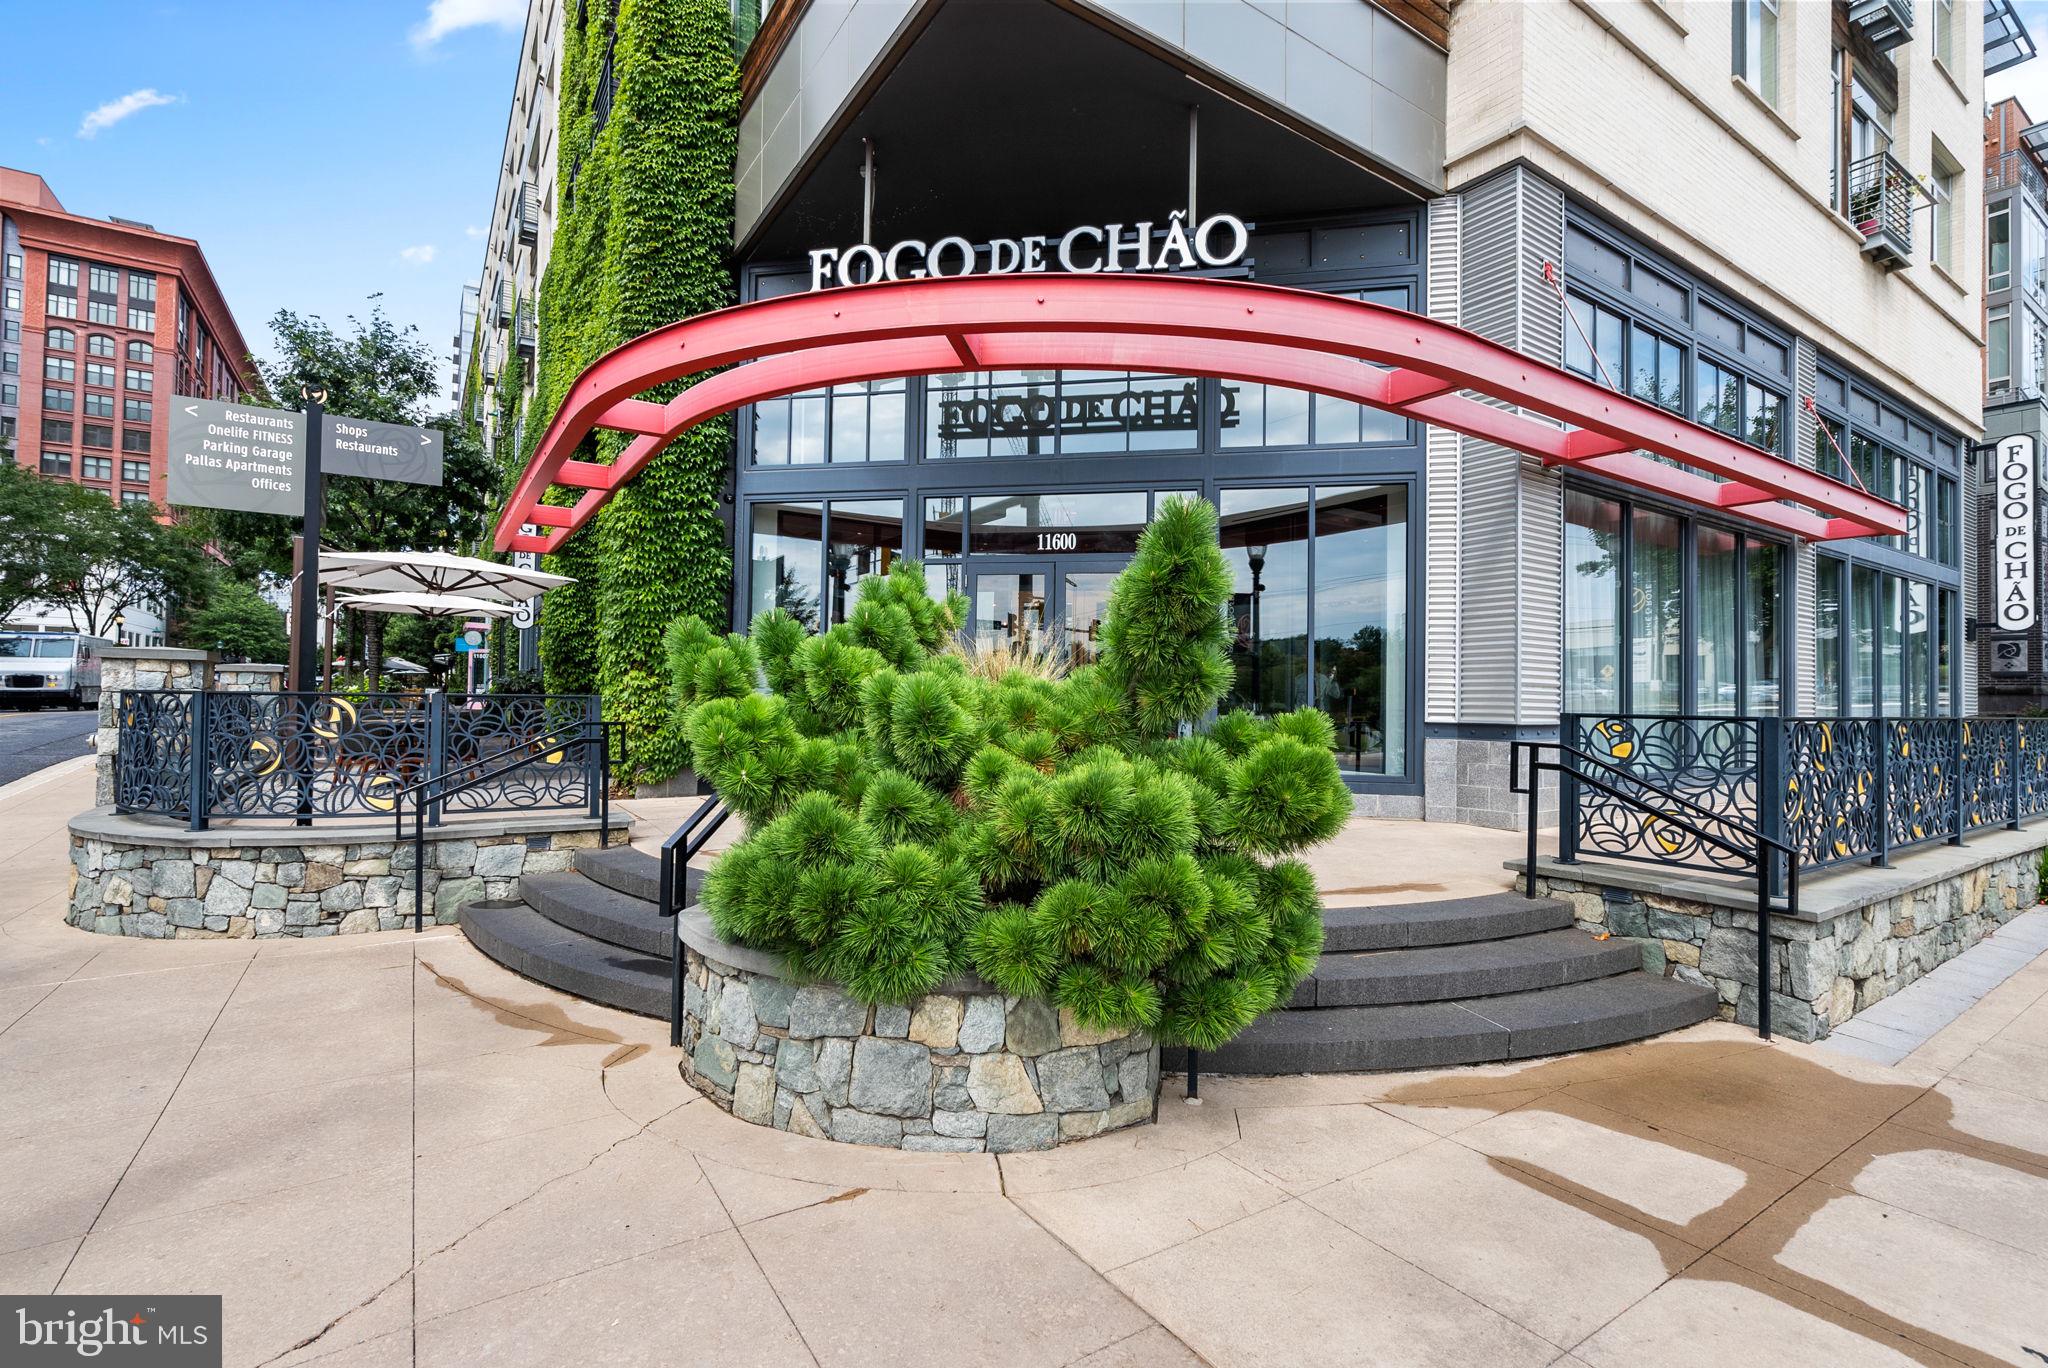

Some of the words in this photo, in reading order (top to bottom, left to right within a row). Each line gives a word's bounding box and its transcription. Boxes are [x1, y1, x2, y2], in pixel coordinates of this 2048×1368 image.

[808, 236, 976, 293] FOGO
[988, 236, 1046, 274] DE
[1058, 209, 1249, 274] CHÃO
[225, 410, 294, 430] Restaurants
[208, 423, 249, 439] Onelife
[253, 429, 294, 445] FITNESS
[335, 423, 368, 439] Shops
[203, 439, 248, 458] Parking
[252, 446, 293, 462] Garage
[335, 438, 399, 457] Restaurants
[185, 453, 222, 468] Pallas
[225, 458, 293, 476] Apartments
[251, 477, 292, 492] Offices
[2002, 444, 2028, 520] FOGO
[1037, 532, 1077, 551] 11600
[2005, 525, 2026, 537] DE
[2004, 541, 2029, 622] CHÃO
